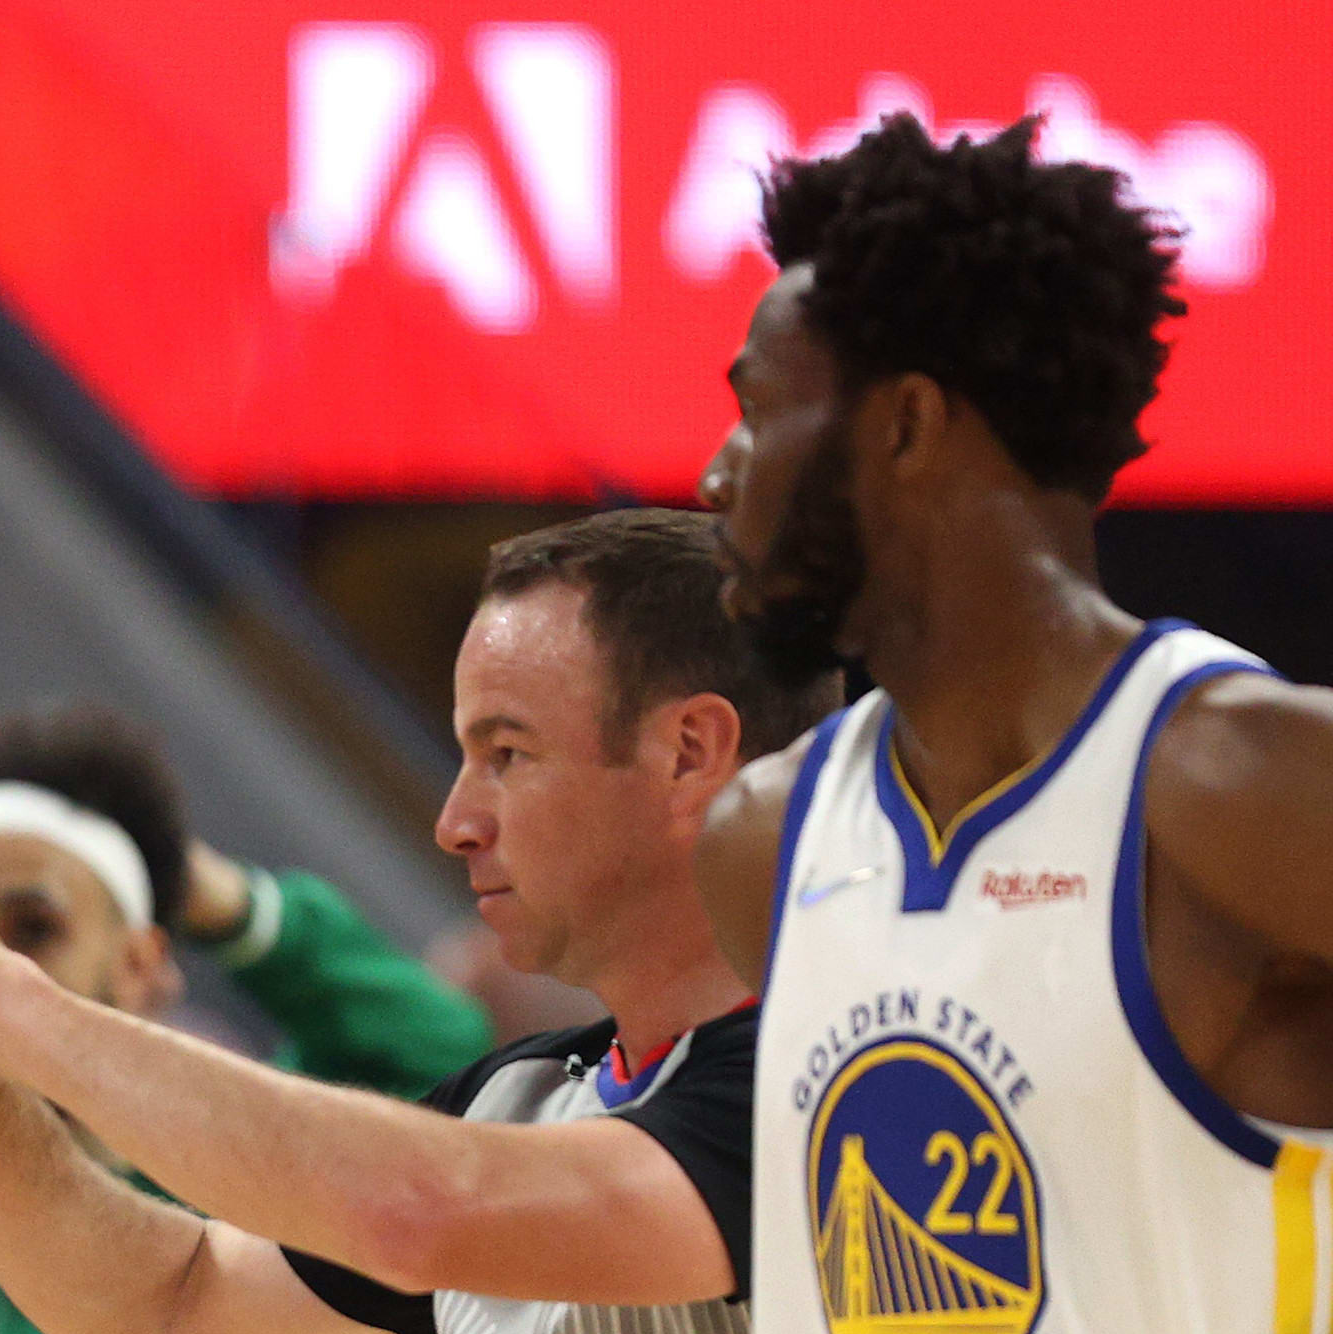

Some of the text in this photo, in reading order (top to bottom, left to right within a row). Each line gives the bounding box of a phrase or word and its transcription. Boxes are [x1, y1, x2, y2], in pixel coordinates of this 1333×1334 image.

[792, 987, 1033, 1110] GOLDEN STATE
[925, 1130, 1020, 1235] 22
